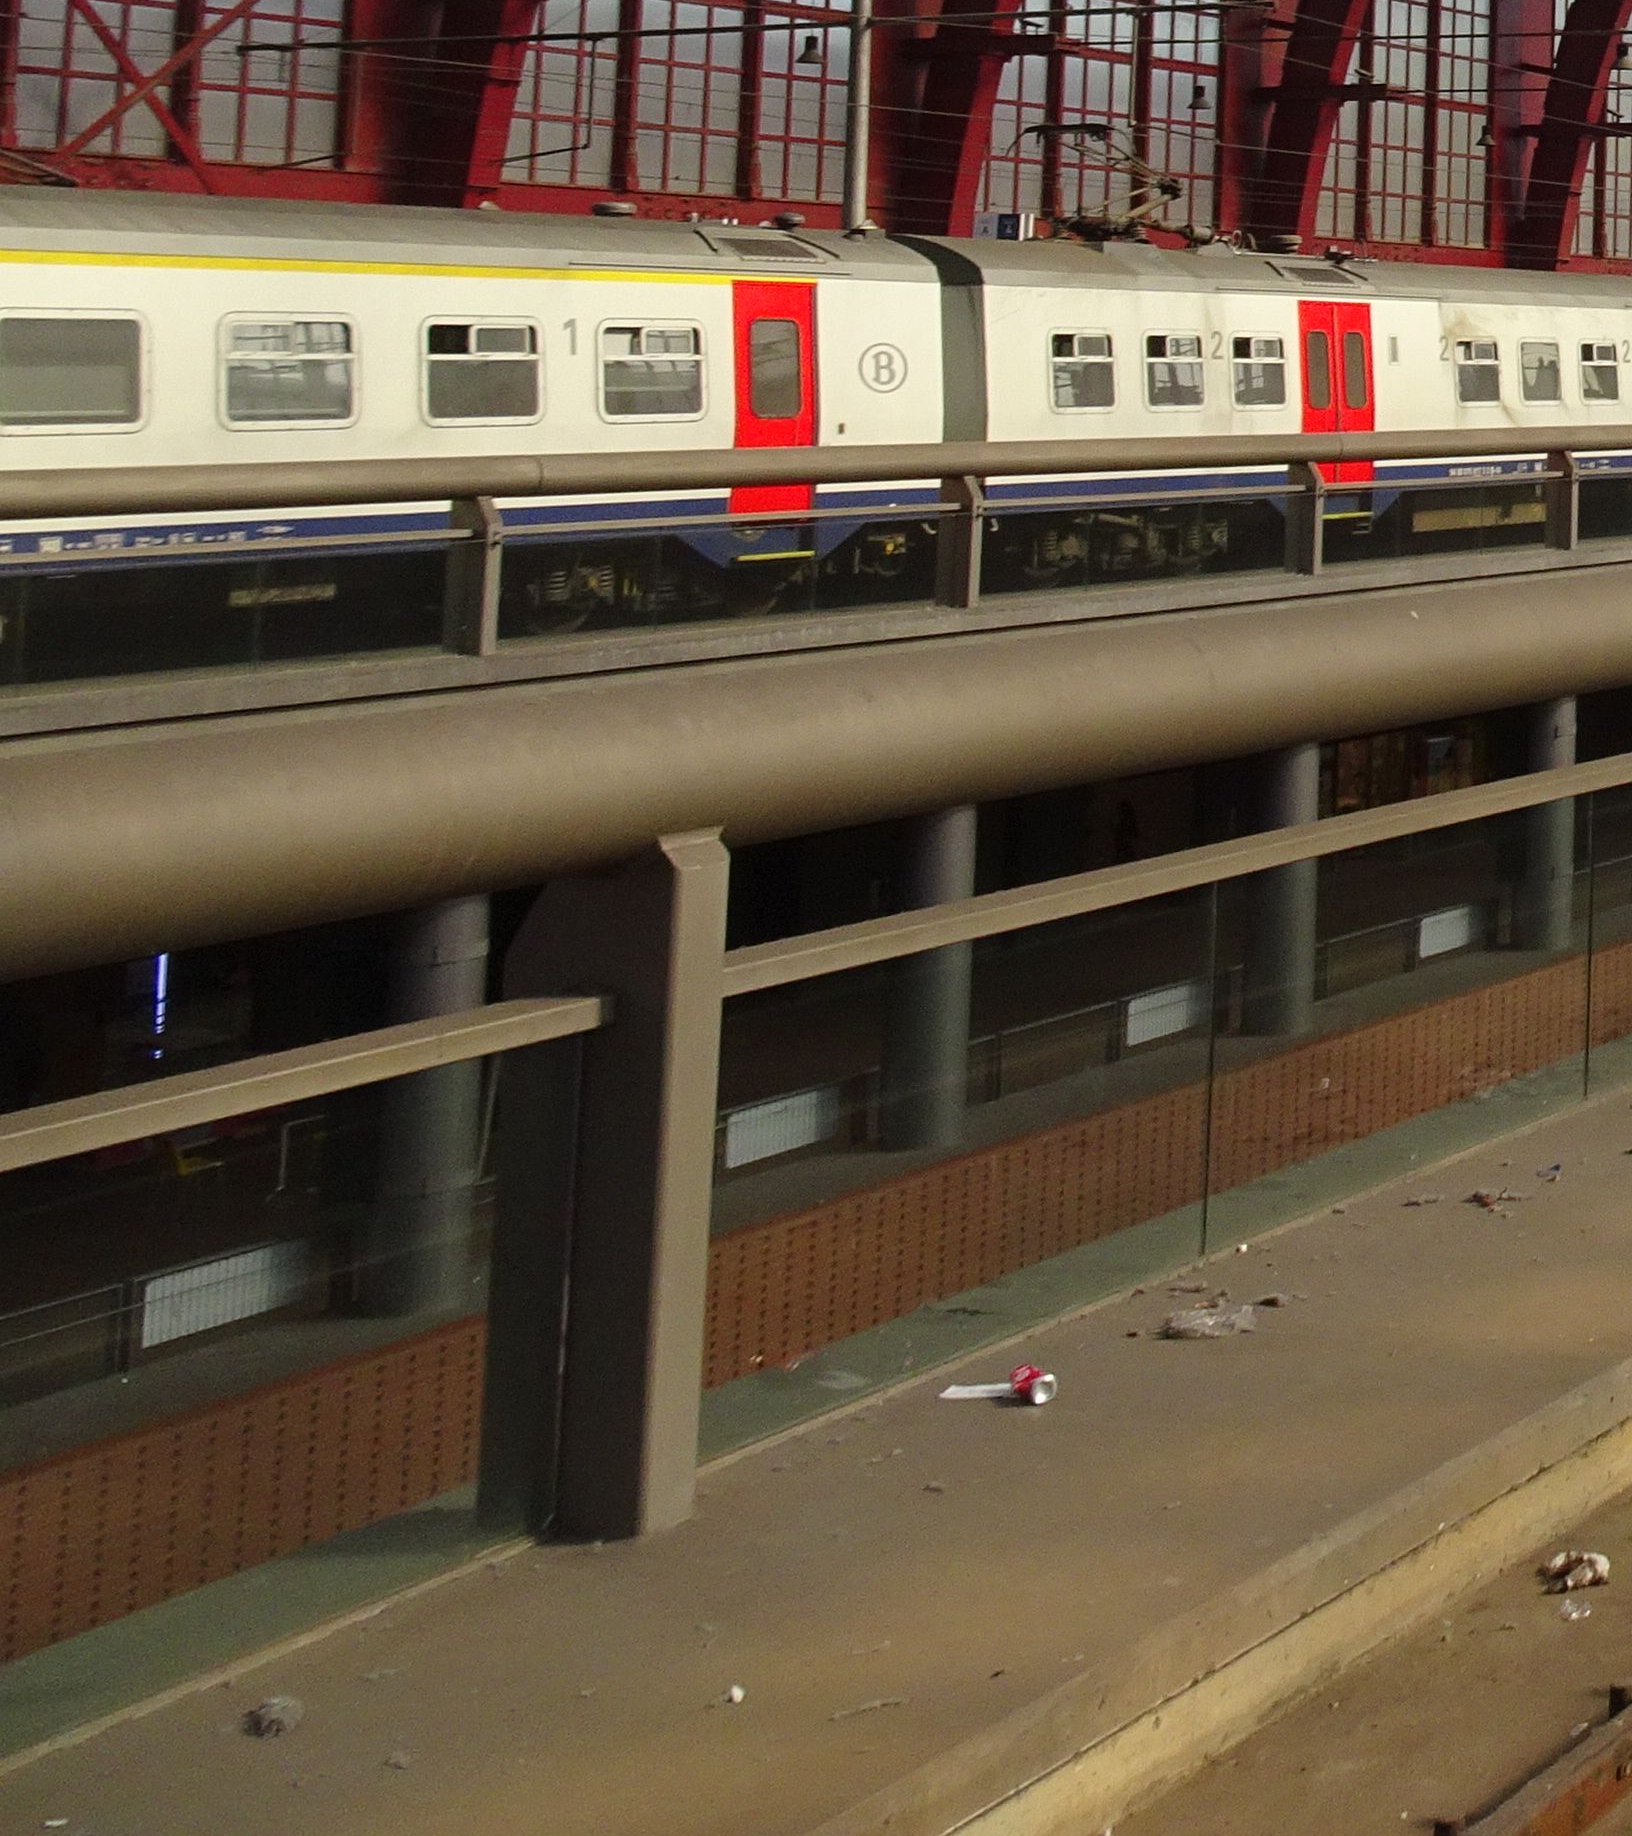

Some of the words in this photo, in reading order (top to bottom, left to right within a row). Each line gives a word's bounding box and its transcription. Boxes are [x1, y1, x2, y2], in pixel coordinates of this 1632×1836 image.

[562, 318, 577, 356] 1
[1210, 330, 1224, 360] 2
[1439, 335, 1450, 361] 2
[1622, 339, 1631, 363] 2
